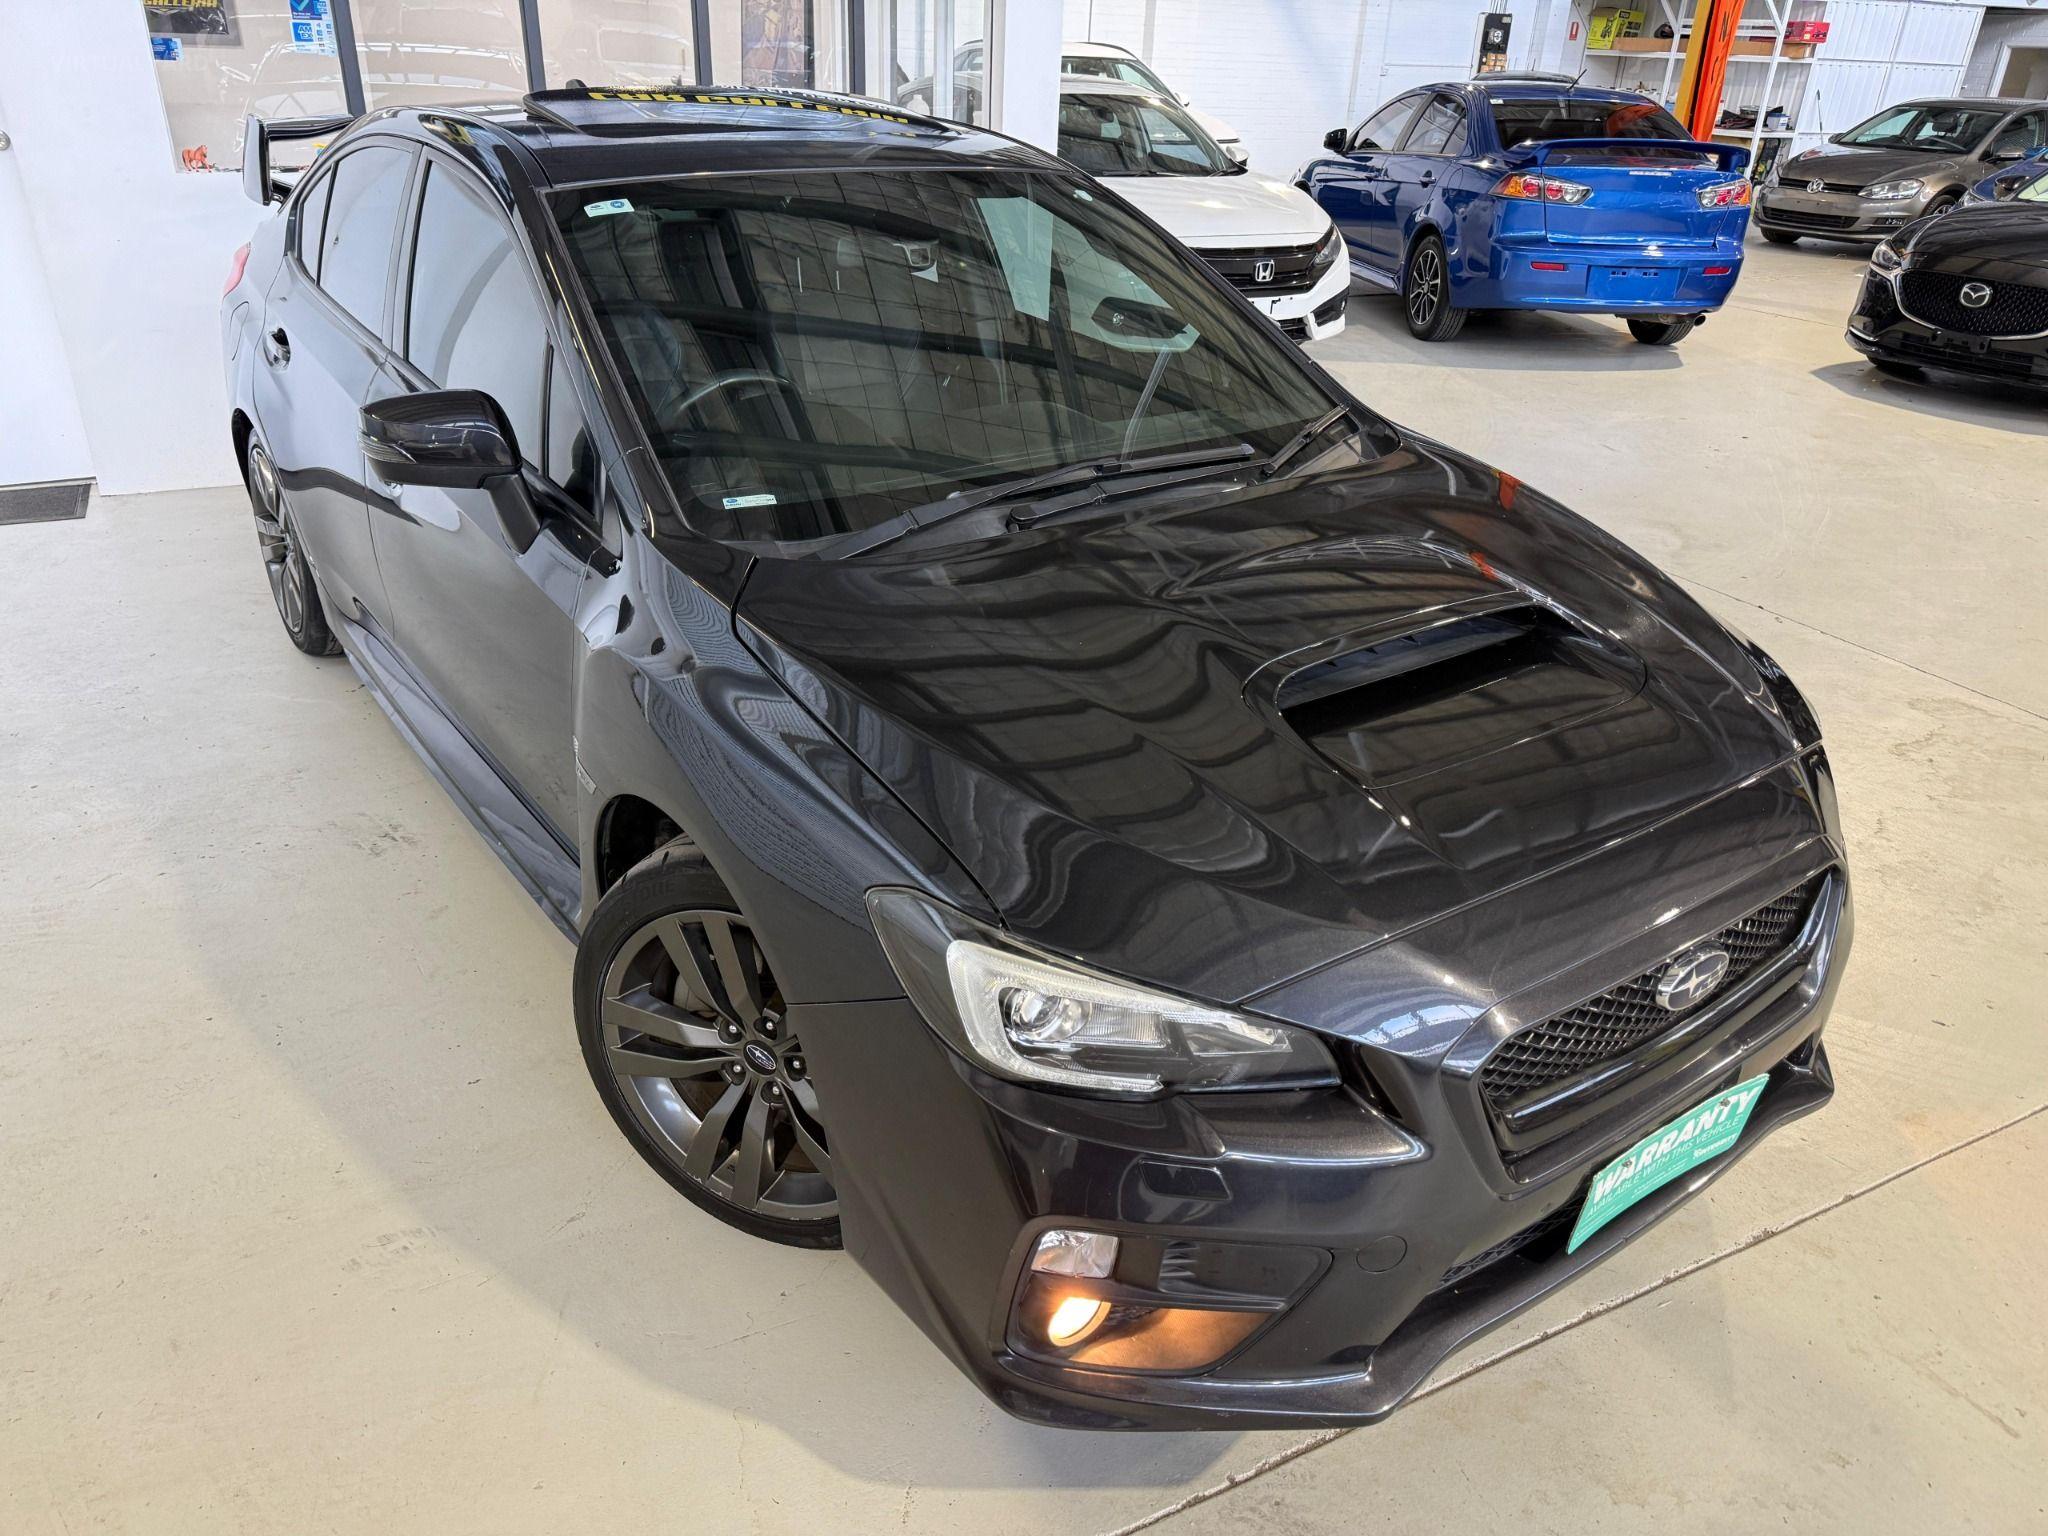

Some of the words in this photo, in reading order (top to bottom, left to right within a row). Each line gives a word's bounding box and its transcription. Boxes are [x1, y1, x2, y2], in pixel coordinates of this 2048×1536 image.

[1585, 1173, 1639, 1219] AVAILABLE
[1642, 1153, 1670, 1178] WITH
[1671, 1140, 1693, 1160] THIS
[1696, 1113, 1744, 1145] VEHICLE
[1593, 1085, 1761, 1204] WARRANTY
